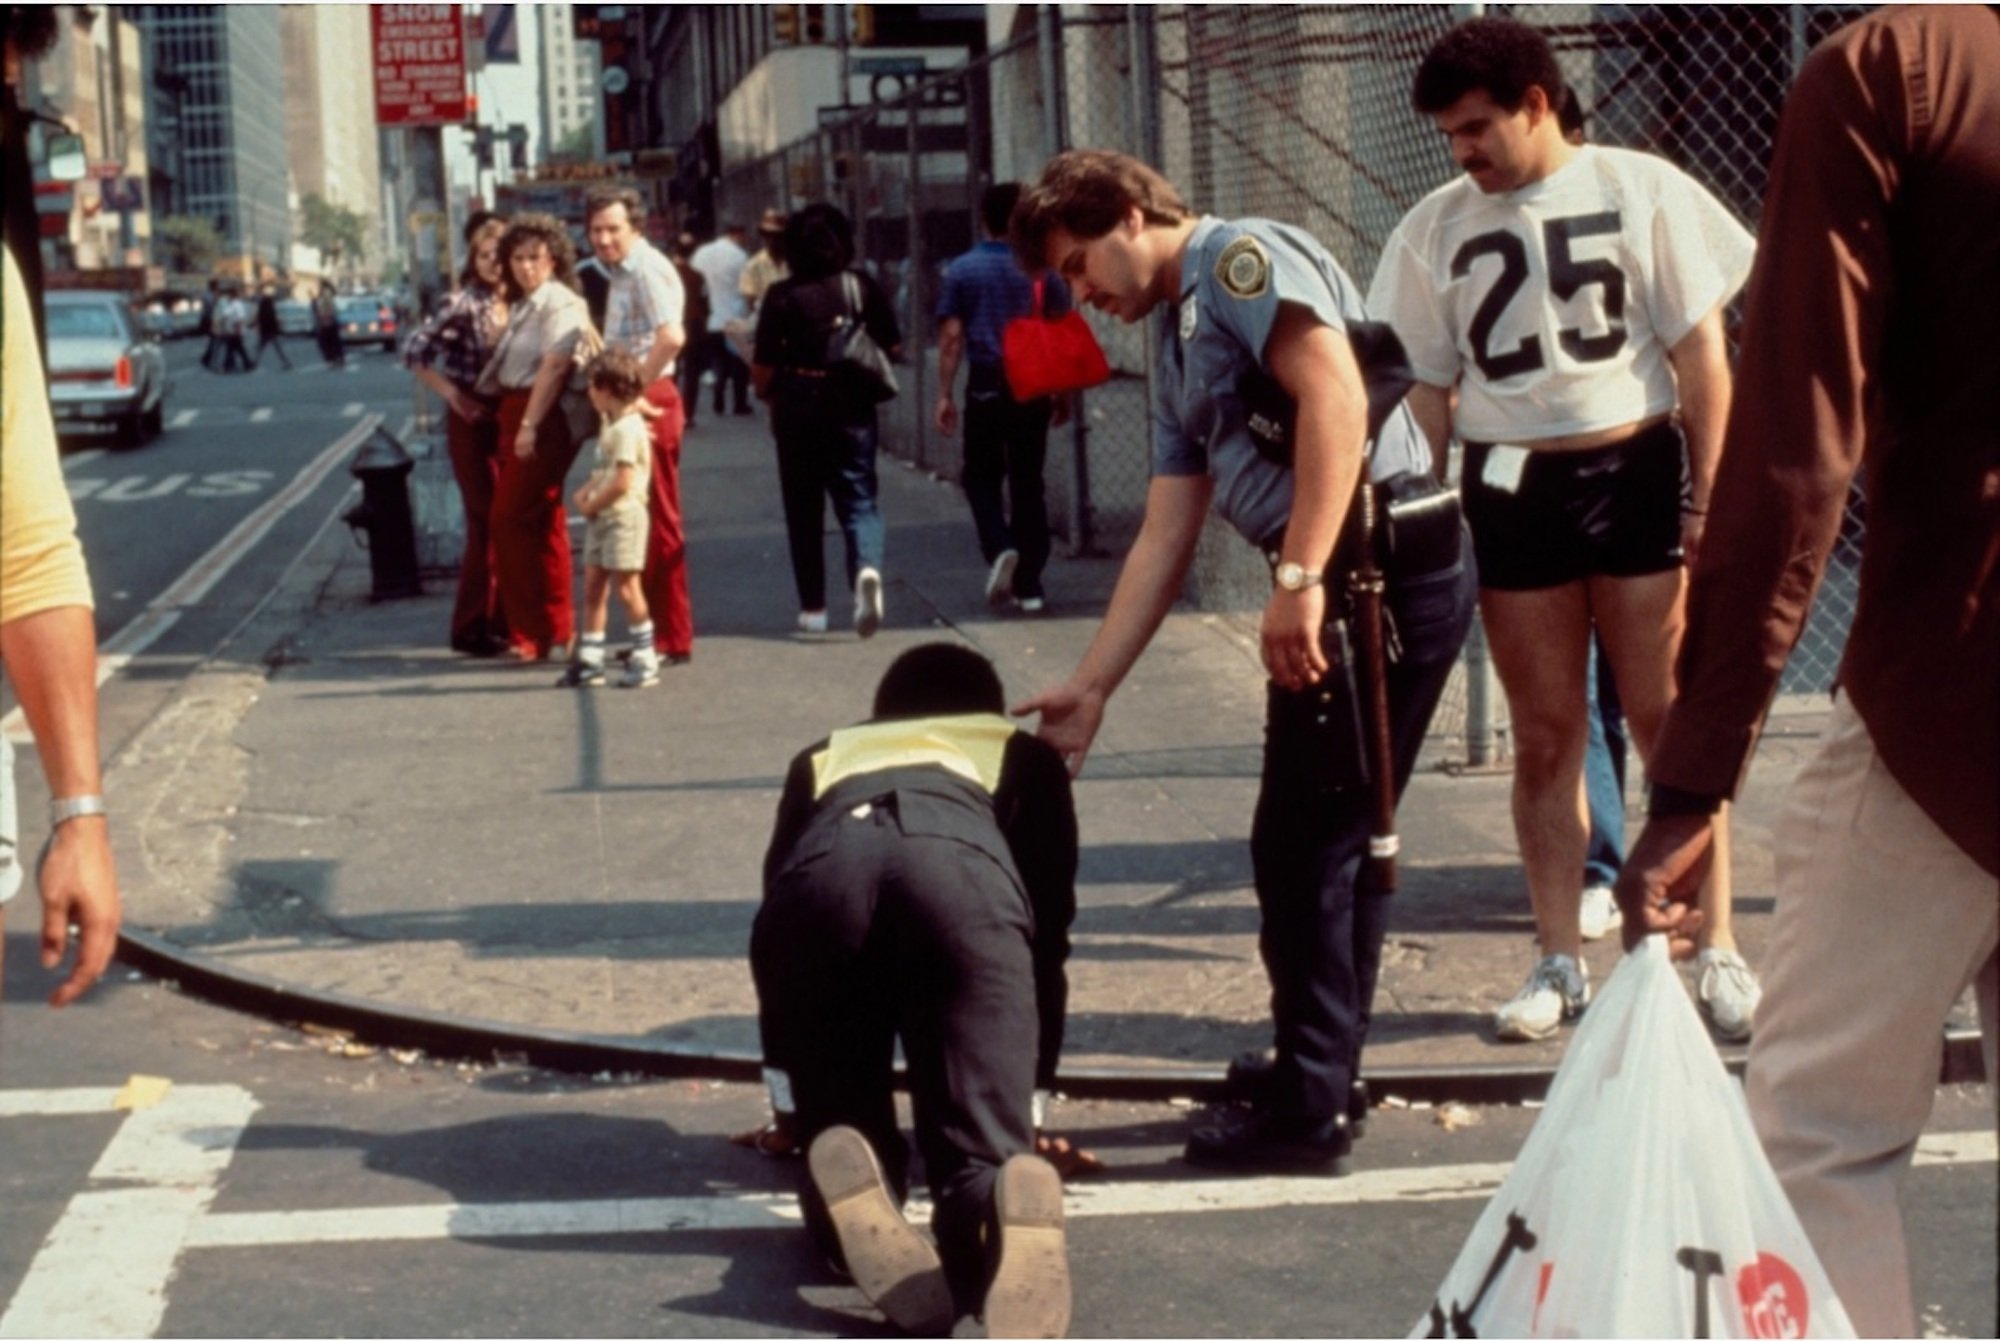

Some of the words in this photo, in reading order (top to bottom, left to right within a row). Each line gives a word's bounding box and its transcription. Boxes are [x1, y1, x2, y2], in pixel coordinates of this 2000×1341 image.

[381, 4, 450, 22] SNOW
[378, 39, 458, 61] STREET
[1451, 212, 1627, 382] 25
